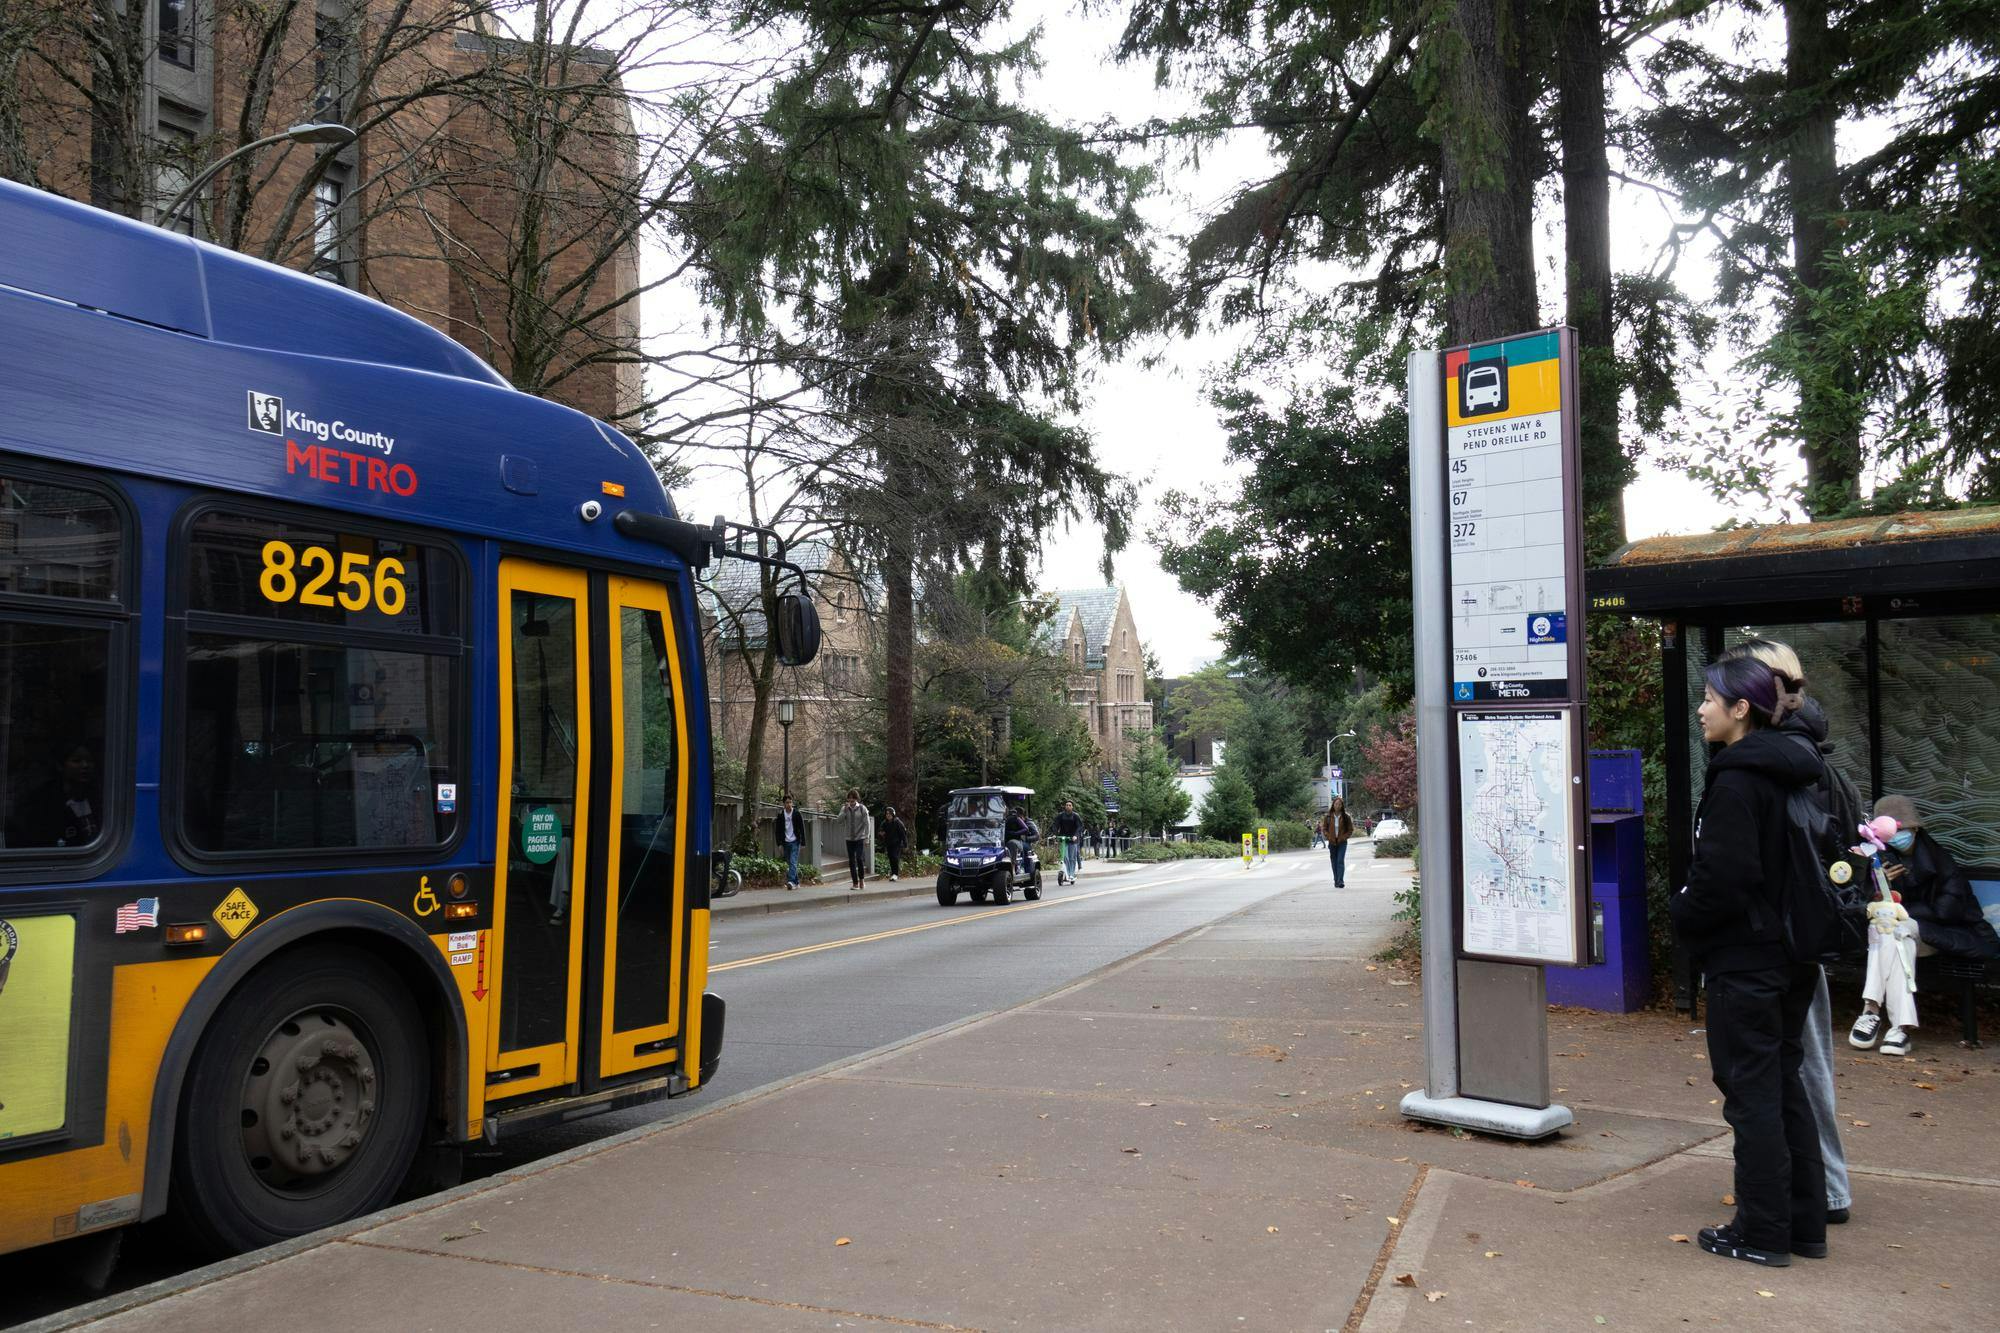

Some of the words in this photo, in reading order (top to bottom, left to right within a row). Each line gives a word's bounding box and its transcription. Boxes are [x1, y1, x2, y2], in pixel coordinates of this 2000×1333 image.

[286, 409, 329, 441] King
[332, 421, 395, 455] County
[1467, 425, 1507, 438] STEVENS
[1511, 421, 1531, 431] WAY
[1463, 440, 1487, 450] PEND
[1492, 434, 1529, 446] OREILLE
[1534, 431, 1547, 439] RD
[287, 440, 418, 496] METRO
[1452, 460, 1467, 474] 45
[1453, 492, 1467, 505] 67
[1453, 523, 1475, 537] 372
[260, 541, 405, 615] 8256
[1593, 597, 1625, 608] 75406
[1498, 688, 1530, 697] METRO
[533, 822, 553, 831] ENTRY
[528, 836, 547, 844] PAGUE
[226, 902, 246, 911] SAFE
[6, 927, 17, 950] HOME
[453, 955, 471, 963] RAMP
